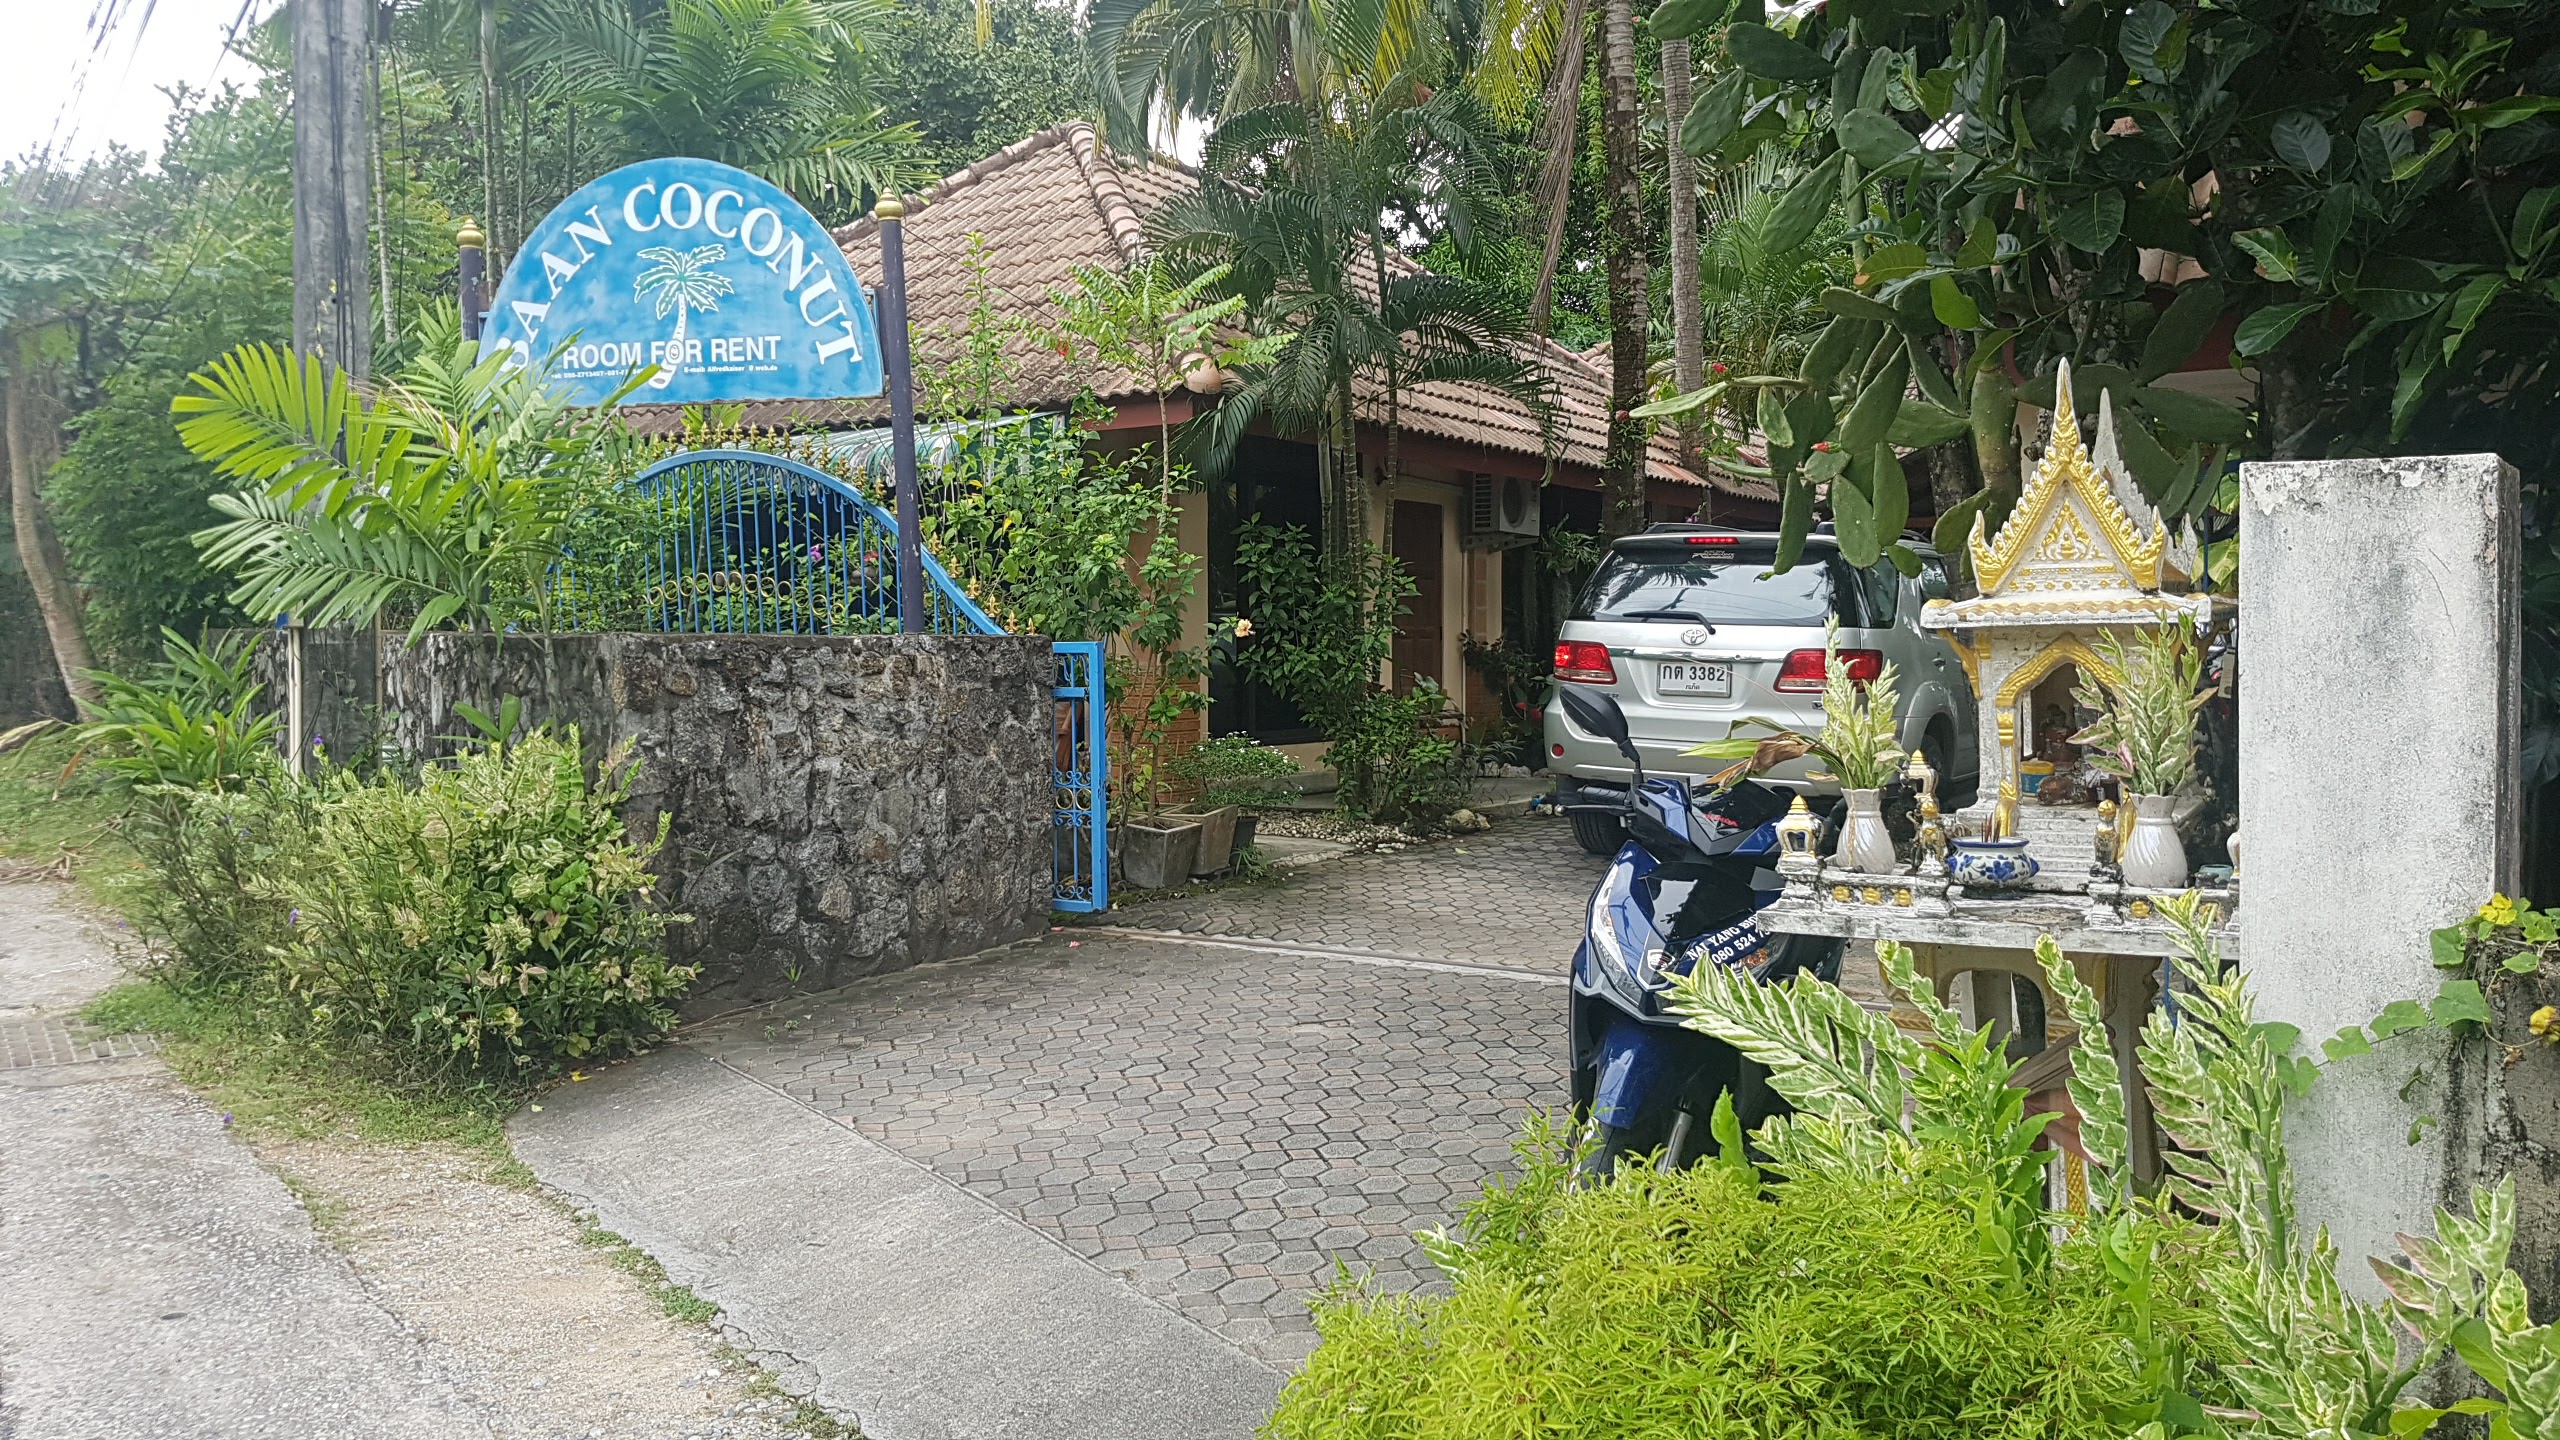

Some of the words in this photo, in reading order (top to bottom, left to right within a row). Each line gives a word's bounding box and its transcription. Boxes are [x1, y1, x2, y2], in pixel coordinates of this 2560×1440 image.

[623, 182, 863, 365] COCONUT
[563, 342, 642, 370] ROOM
[651, 339, 703, 365] FOR
[711, 335, 781, 362] RENT
[1689, 666, 1725, 682] 3382
[1686, 942, 1709, 960] NAI
[1707, 926, 1741, 946] YANG
[1711, 946, 1735, 964] 080
[1733, 933, 1757, 950] 524
